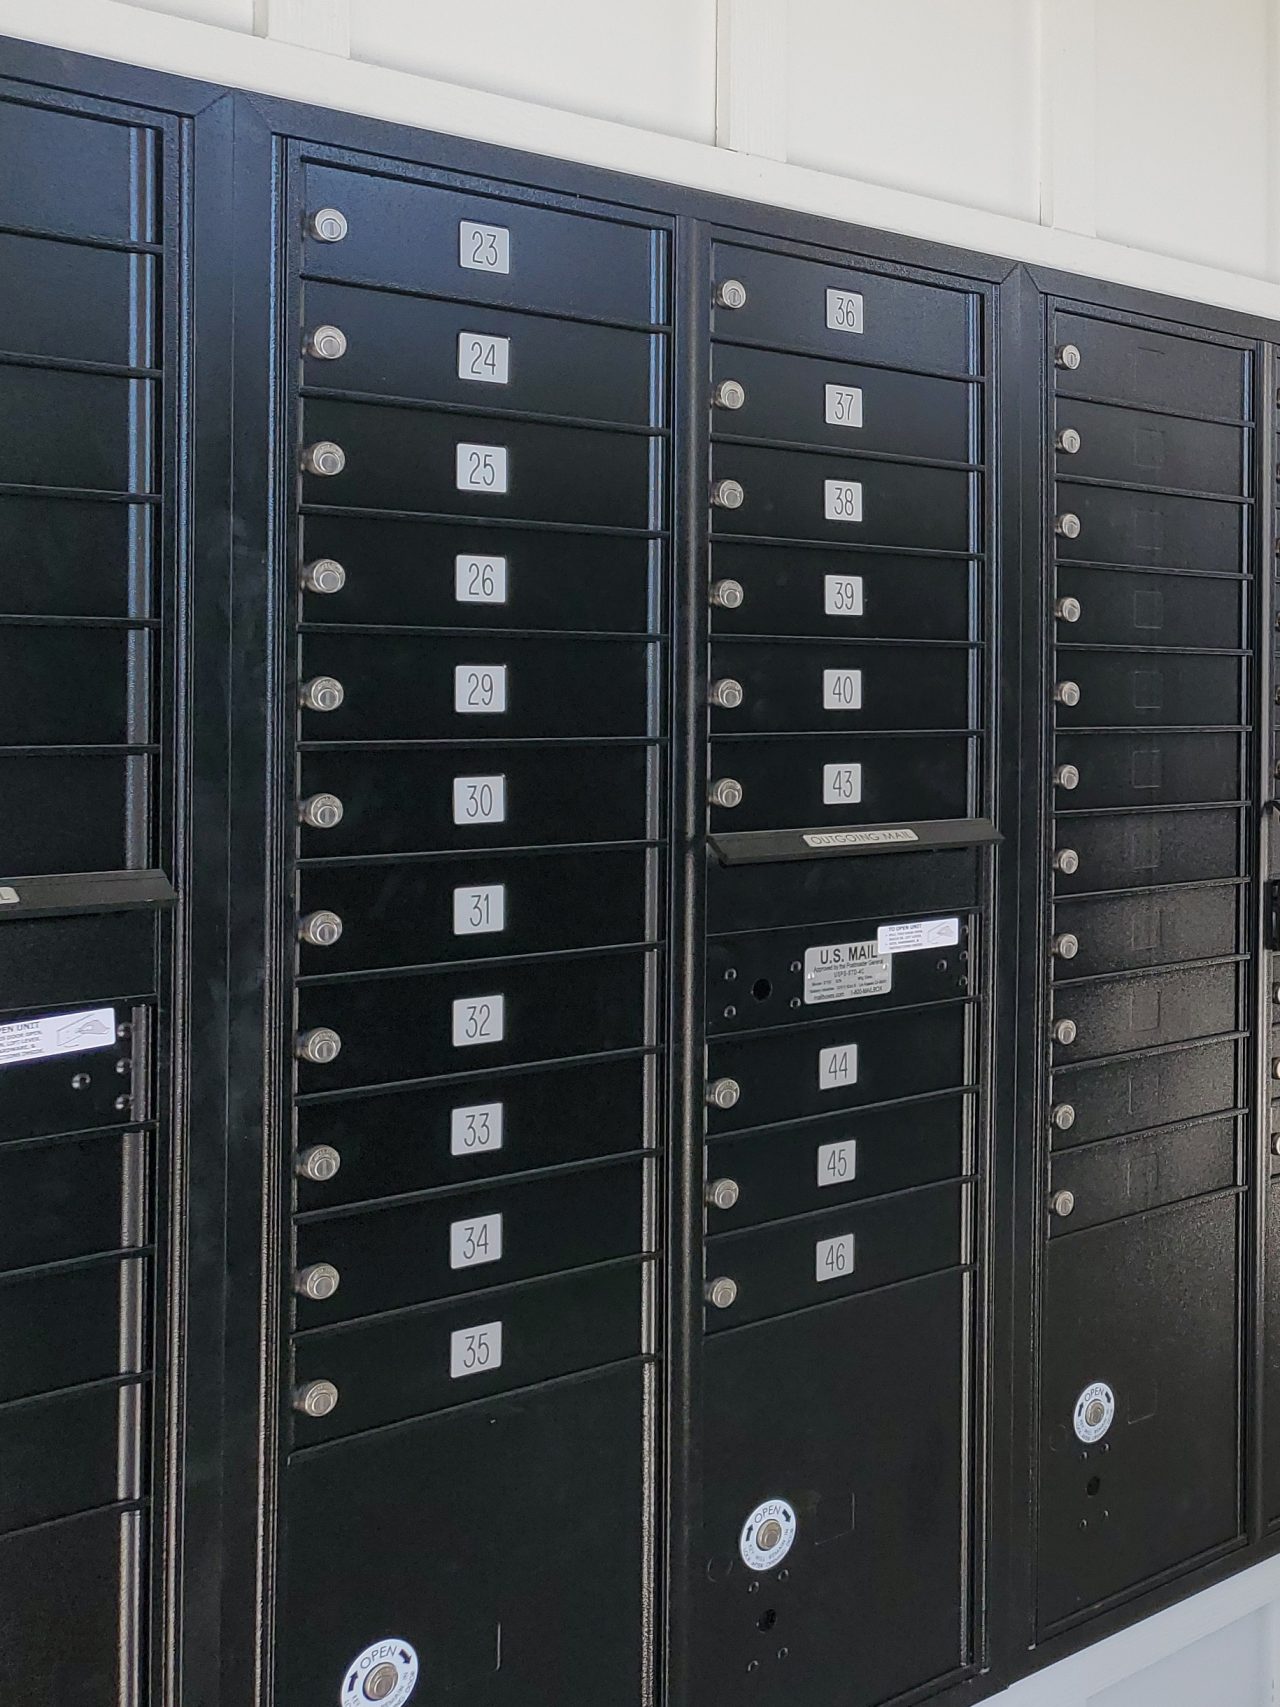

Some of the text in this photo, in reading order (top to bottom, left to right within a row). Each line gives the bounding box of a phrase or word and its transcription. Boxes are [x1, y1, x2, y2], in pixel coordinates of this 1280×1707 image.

[471, 230, 498, 266] 23
[834, 296, 856, 328] 36
[470, 341, 497, 376] 24
[834, 391, 855, 421] 37
[469, 451, 495, 487] 25
[833, 487, 854, 517] 38
[468, 562, 494, 597] 26
[834, 581, 855, 611] 39
[467, 672, 494, 706] 29
[832, 675, 854, 704] 40
[832, 770, 853, 798] 43
[465, 783, 493, 818] 30
[810, 830, 913, 845] OUTGOING MAIL
[468, 893, 490, 927] 31
[820, 944, 878, 965] U.S. MAIL
[17, 1022, 39, 1031] UNIT
[465, 1003, 491, 1039] 32
[828, 1051, 848, 1081] 44
[463, 1112, 490, 1147] 33
[827, 1148, 847, 1177] 45
[463, 1223, 489, 1260] 34
[825, 1242, 846, 1272] 46
[463, 1332, 490, 1369] 35
[1084, 1386, 1105, 1402] OPEN
[755, 1505, 781, 1523] OPEN
[360, 1645, 398, 1669] OPEN
